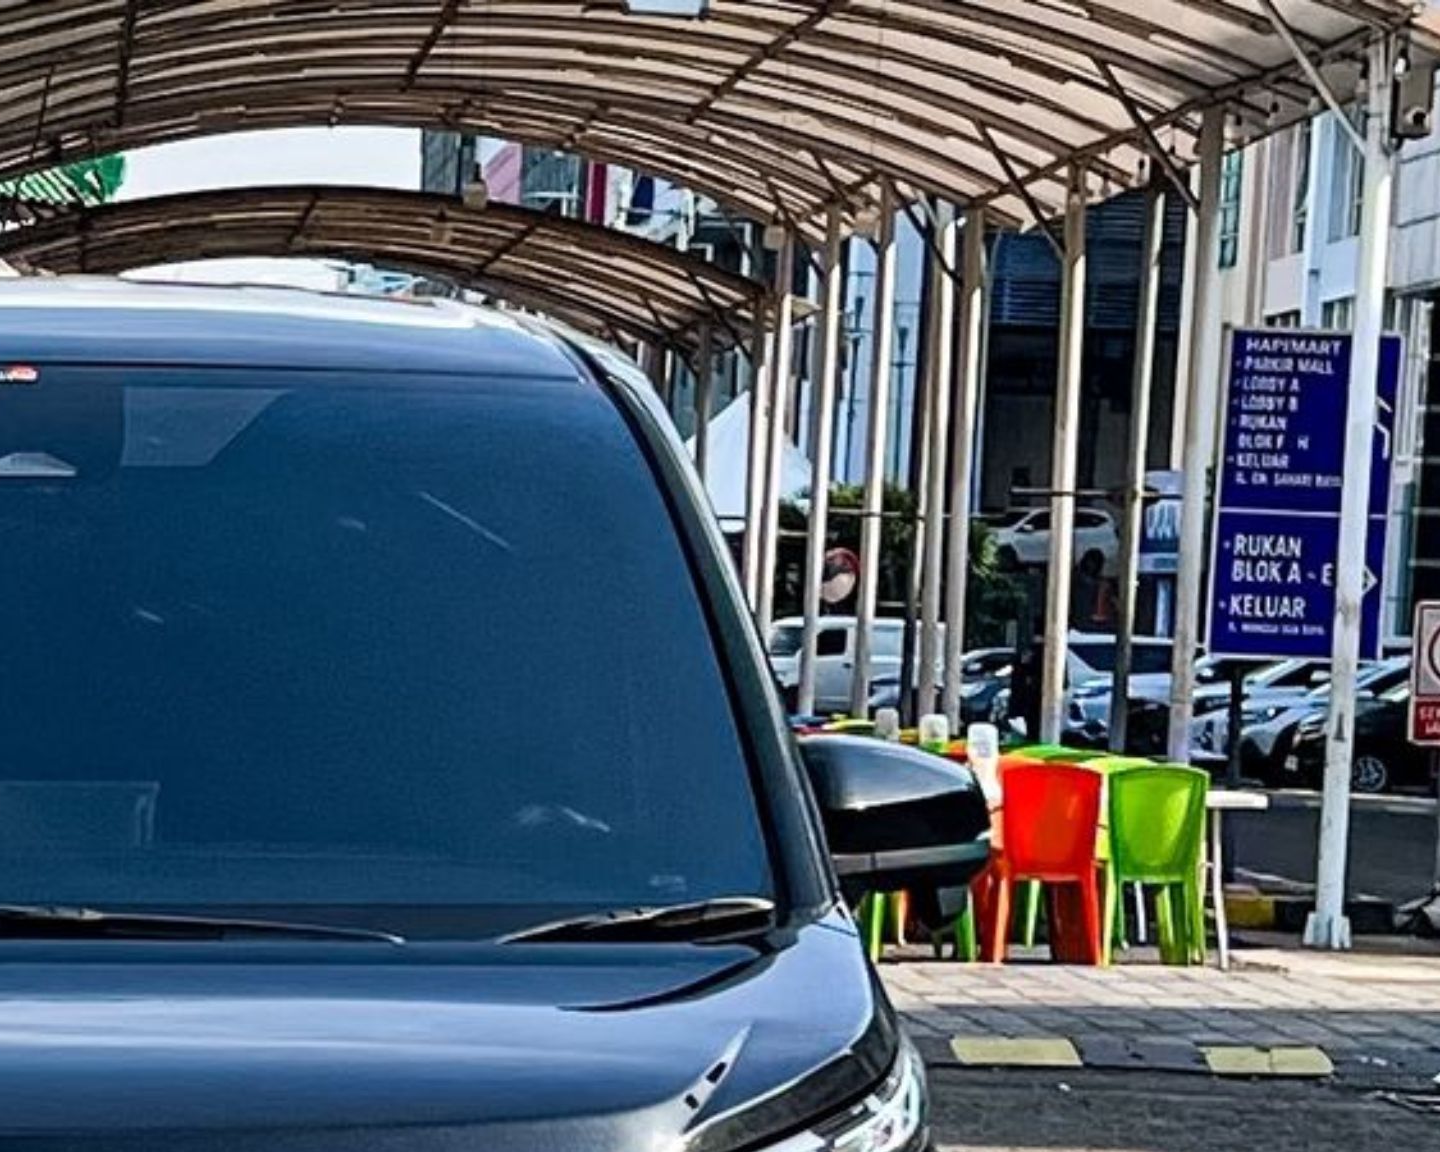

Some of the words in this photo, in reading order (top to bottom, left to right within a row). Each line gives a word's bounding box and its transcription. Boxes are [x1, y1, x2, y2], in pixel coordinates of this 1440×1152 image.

[1244, 355, 1293, 373] PARKIR
[1297, 357, 1334, 375] MALL
[1243, 375, 1286, 392] LOBBY
[1289, 378, 1300, 392] A
[1241, 394, 1285, 411] LOBBY
[1239, 414, 1287, 431] RUKAN
[1238, 433, 1273, 450] BLOK
[1236, 452, 1289, 469] KELUAR
[1233, 533, 1302, 558] RUKAN
[1231, 559, 1282, 584] BLOK
[1287, 561, 1302, 584] A
[1321, 562, 1334, 587] E
[1228, 593, 1306, 619] KELUAR
